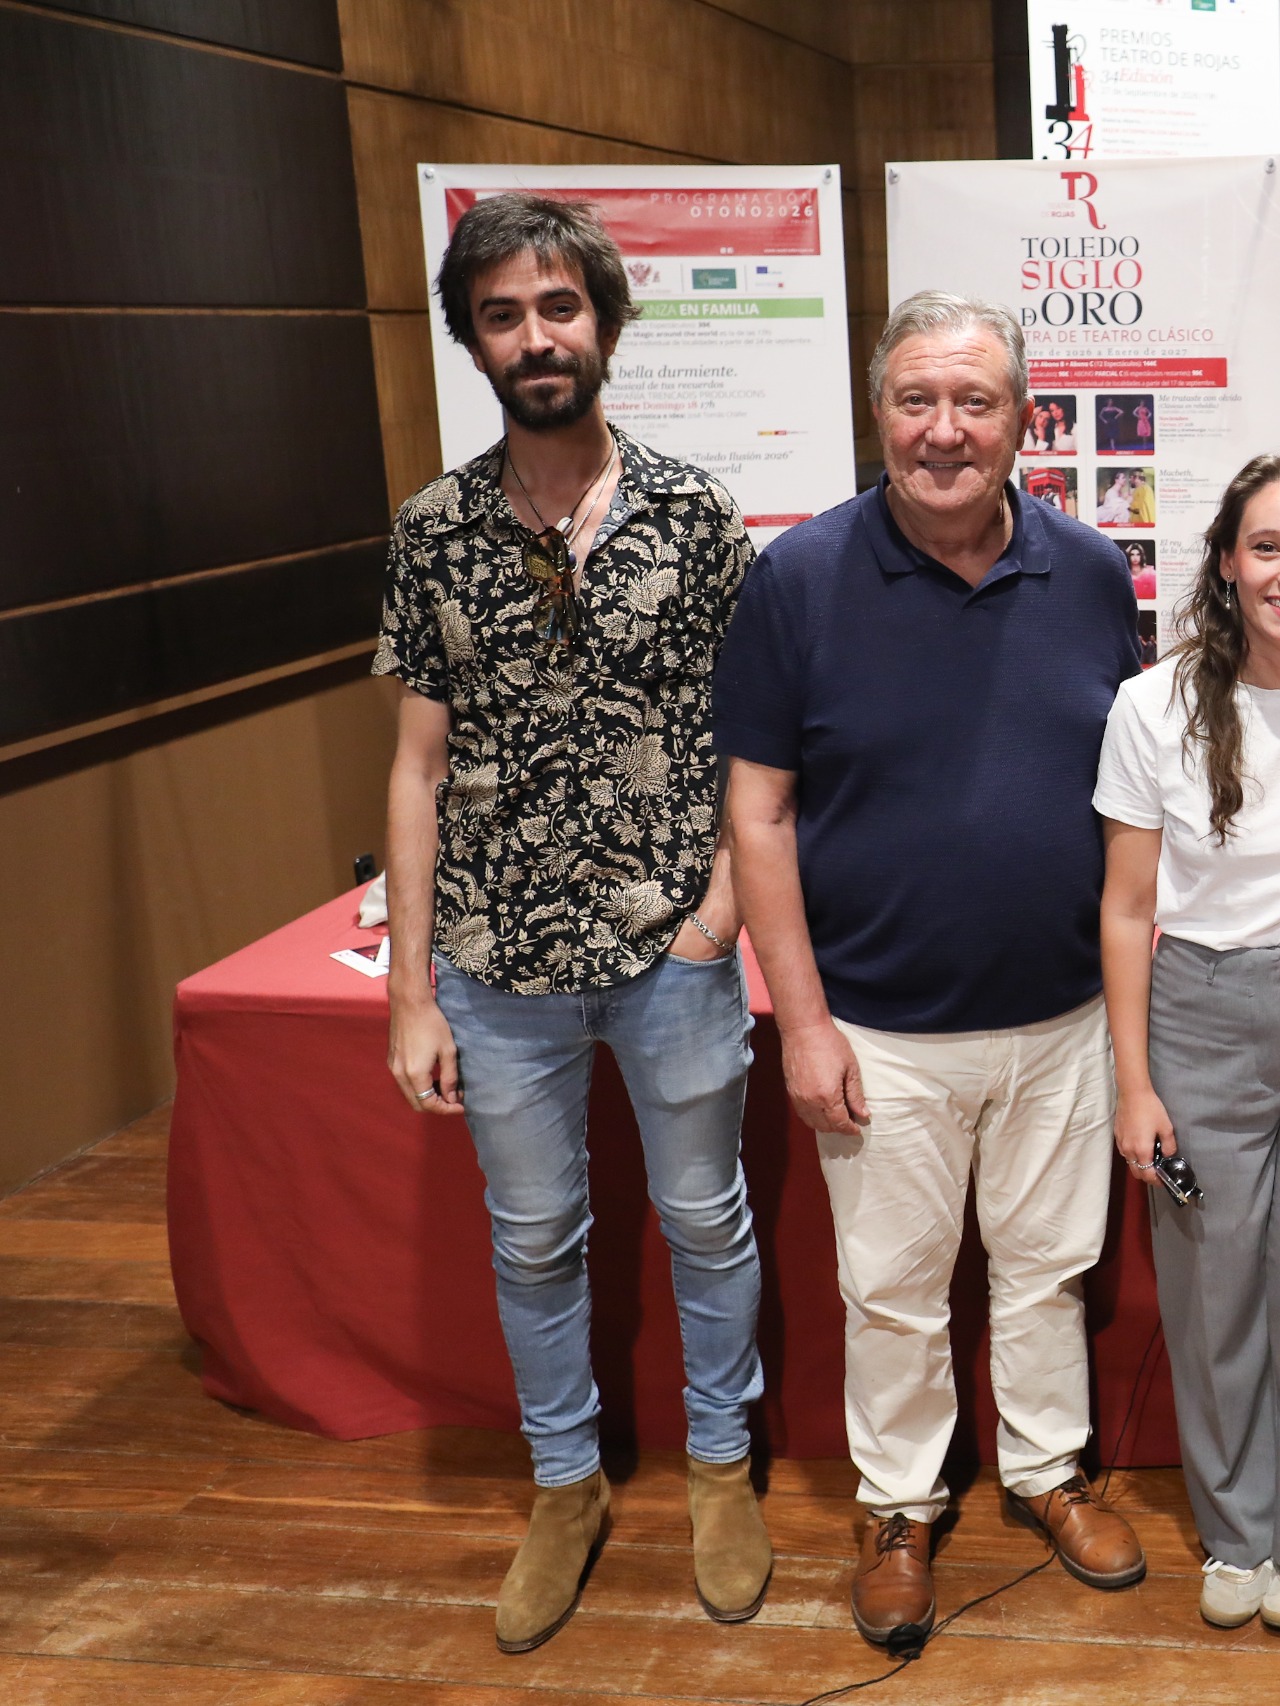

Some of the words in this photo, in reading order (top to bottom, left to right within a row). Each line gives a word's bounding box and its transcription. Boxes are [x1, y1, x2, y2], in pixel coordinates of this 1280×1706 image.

[1100, 28, 1172, 47] PREMIOS
[1100, 47, 1162, 65] TEATRO
[1168, 51, 1188, 67] DE
[1194, 53, 1240, 71] ROJAS
[651, 191, 812, 204] PROGRAMACIÓN
[690, 204, 813, 218] OTOÑO2026
[1051, 210, 1076, 218] ROJAS
[1021, 236, 1140, 258] TOLEDO
[1021, 259, 1142, 290] SIGLO
[680, 305, 698, 316] EN
[703, 303, 759, 316] FAMILIA
[1041, 291, 1142, 326] ORO
[1057, 330, 1076, 343] DE
[1083, 329, 1143, 343] TEATRO
[1147, 326, 1214, 343] CLÁSICO
[1049, 348, 1060, 357] de
[1107, 348, 1140, 357] Enero
[1144, 348, 1155, 356] de
[1161, 348, 1188, 357] 2027
[619, 366, 653, 379] bella
[658, 365, 738, 378] durmiente.
[608, 382, 645, 391] musical
[647, 382, 658, 390] de
[661, 383, 675, 391] tus
[677, 381, 724, 390] recuerdos
[700, 390, 766, 400] PRODUCCIONS
[643, 402, 685, 411] Domingo
[700, 401, 715, 410] 17h
[729, 451, 762, 462] Ilusión
[707, 463, 741, 475] world
[1170, 540, 1182, 548] rey
